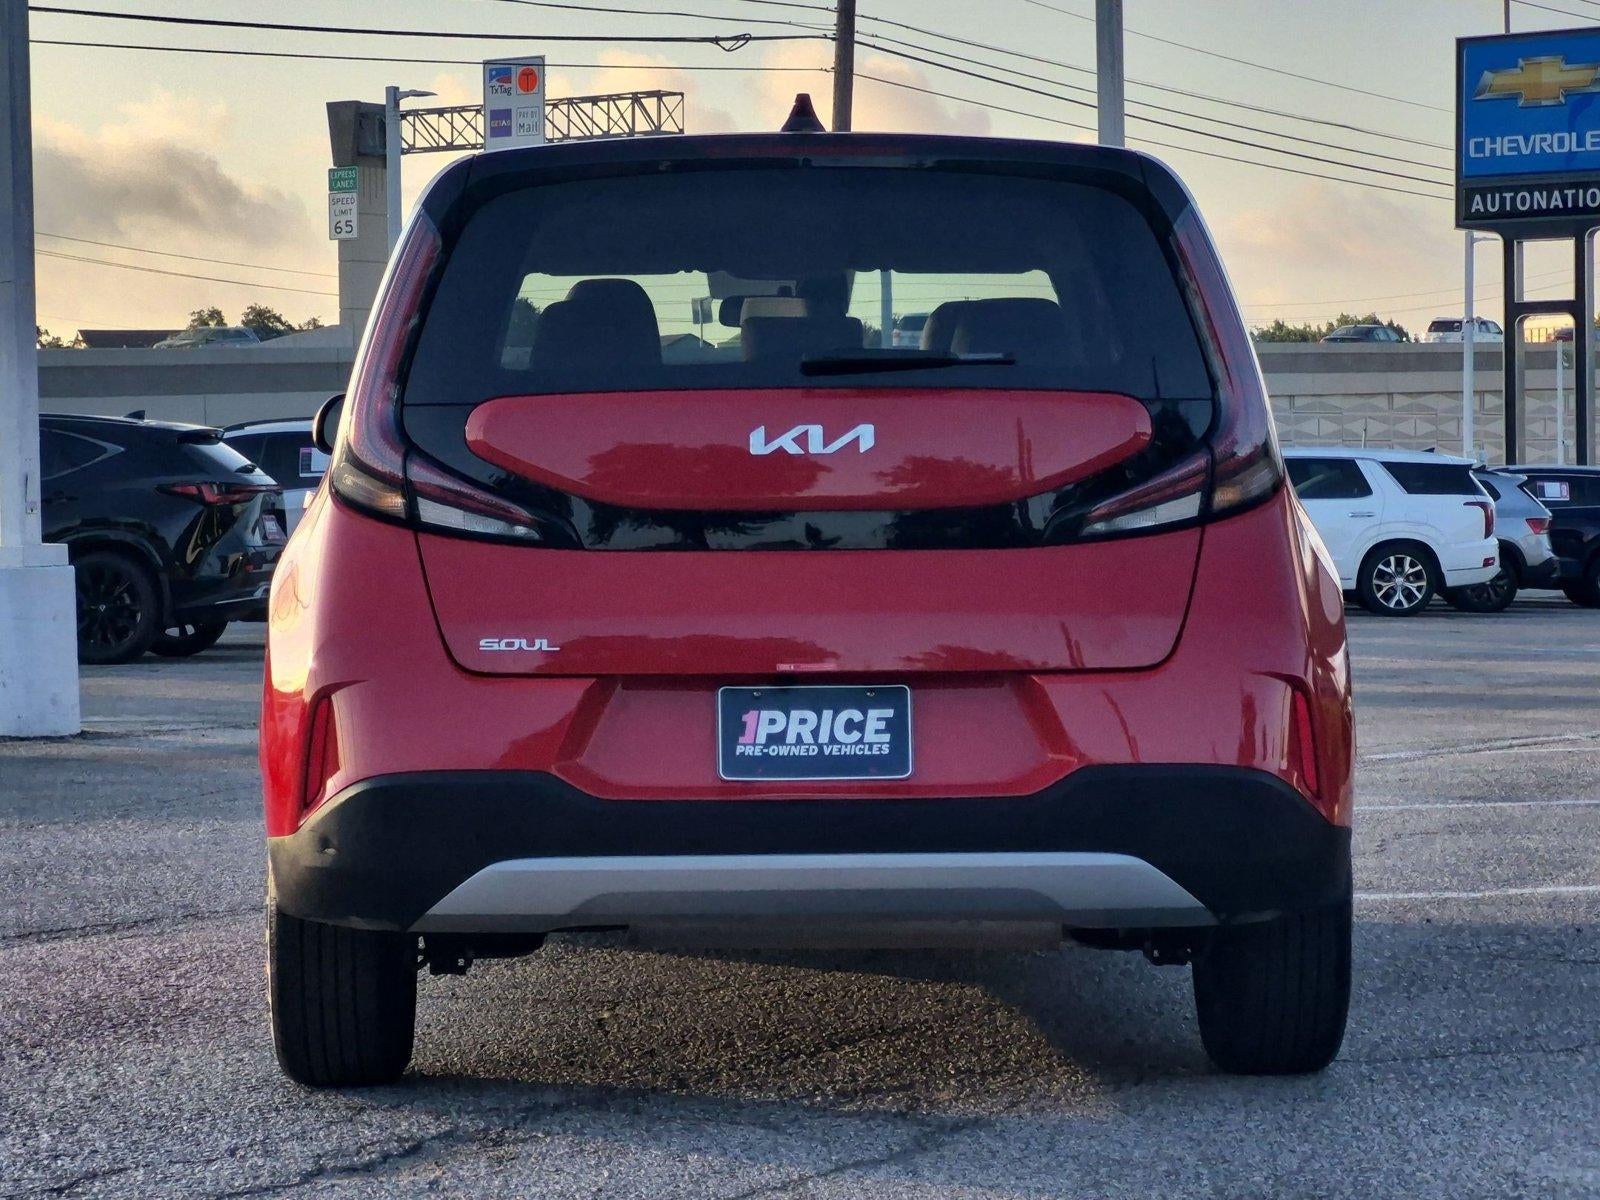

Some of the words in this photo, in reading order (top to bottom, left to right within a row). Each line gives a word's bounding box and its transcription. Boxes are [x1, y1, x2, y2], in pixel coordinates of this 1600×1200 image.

[489, 84, 512, 96] TxTag
[518, 122, 538, 133] Mail
[1469, 130, 1600, 158] CHEVROLE
[332, 179, 354, 189] LANES
[332, 197, 355, 205] SPEED
[1471, 188, 1600, 213] AUTONATIO
[334, 208, 352, 216] LIMIT
[334, 220, 353, 234] 65
[749, 424, 875, 455] KIA
[479, 638, 560, 651] SOUL
[738, 709, 895, 744] 1PRICE
[736, 745, 818, 756] PRE-OWNED
[823, 744, 890, 755] VEHICLES
